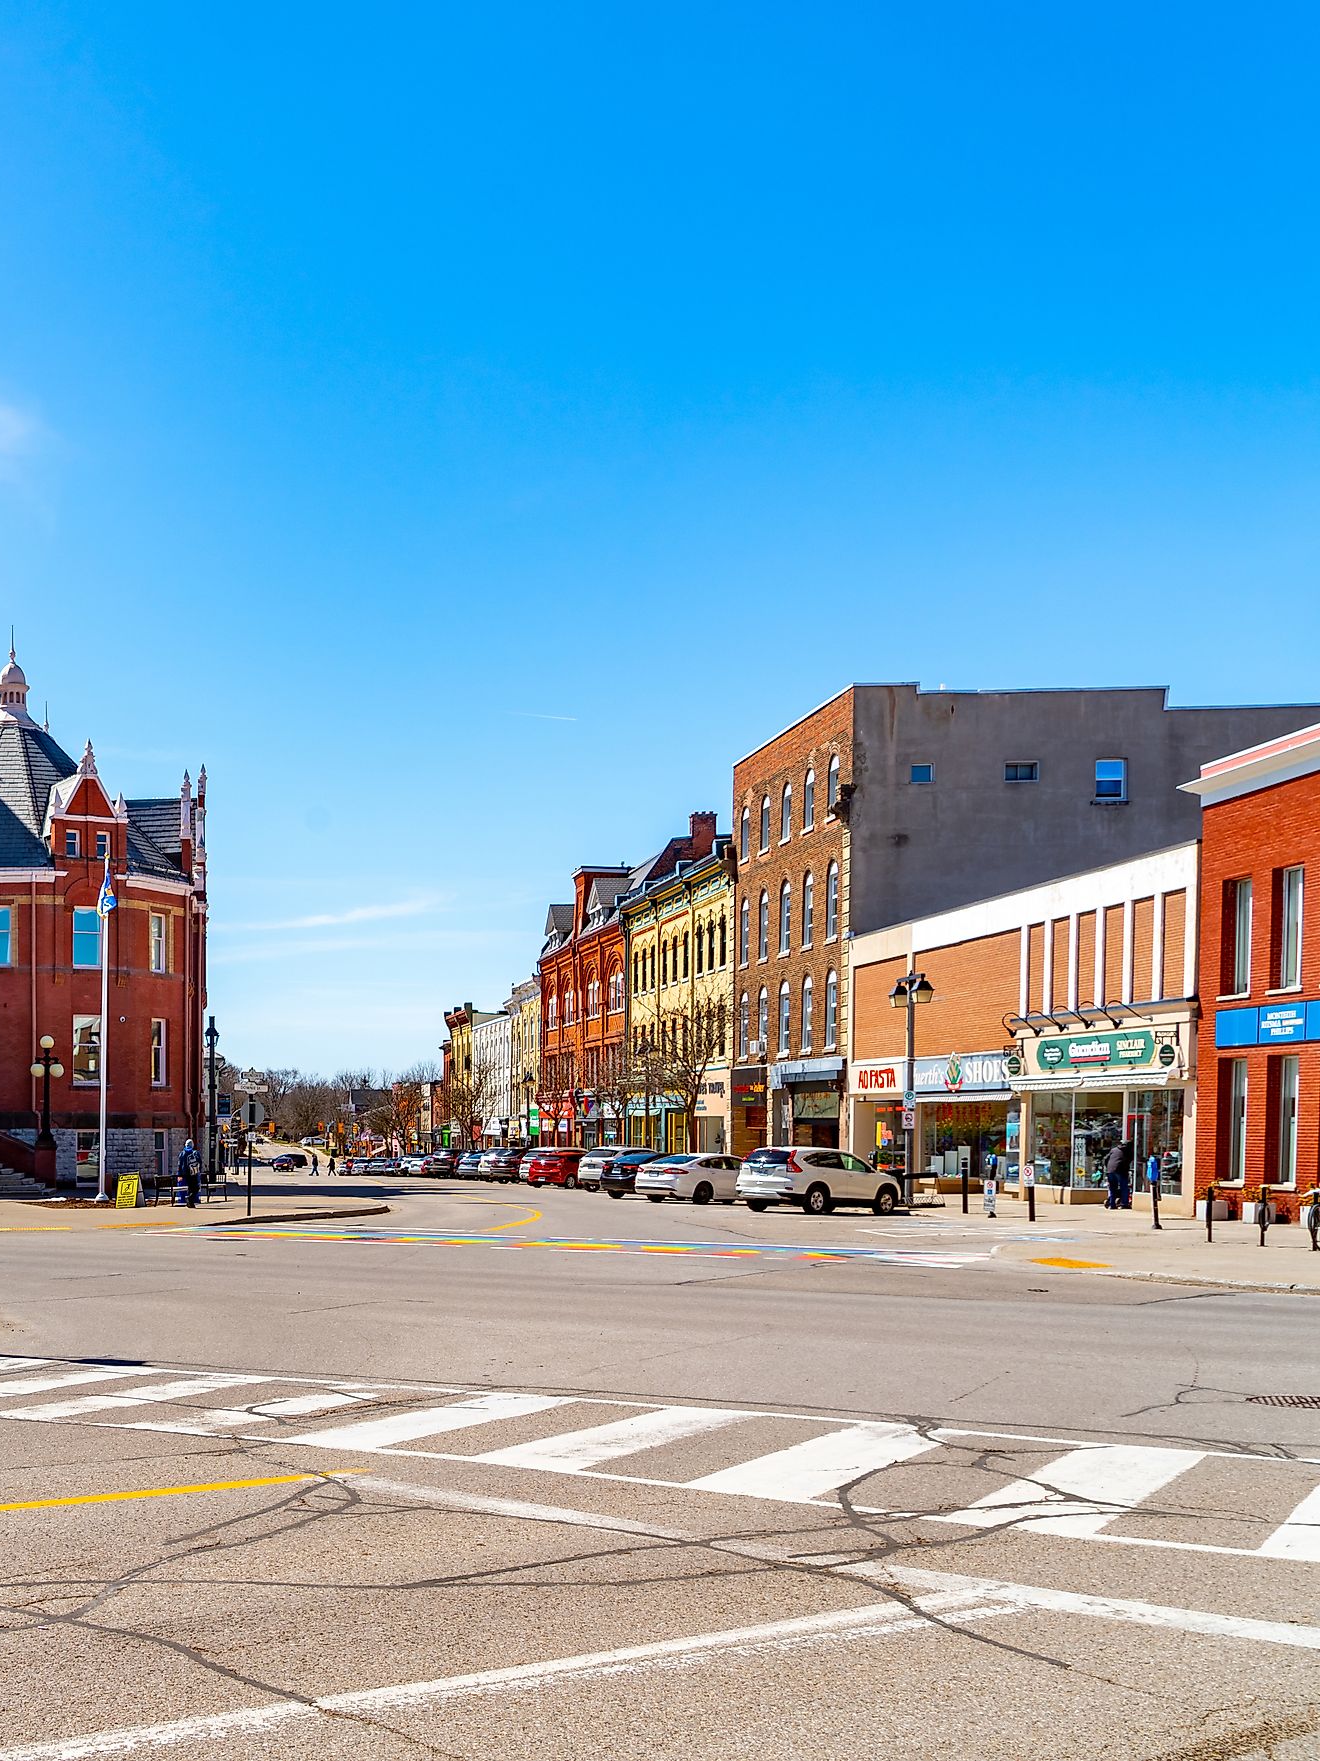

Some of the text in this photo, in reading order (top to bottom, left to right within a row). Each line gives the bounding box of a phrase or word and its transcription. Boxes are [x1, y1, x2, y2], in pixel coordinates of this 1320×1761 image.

[1116, 1038, 1145, 1051] SINCLAIR
[869, 1068, 896, 1088] PASTA
[965, 1059, 1009, 1084] SHOES
